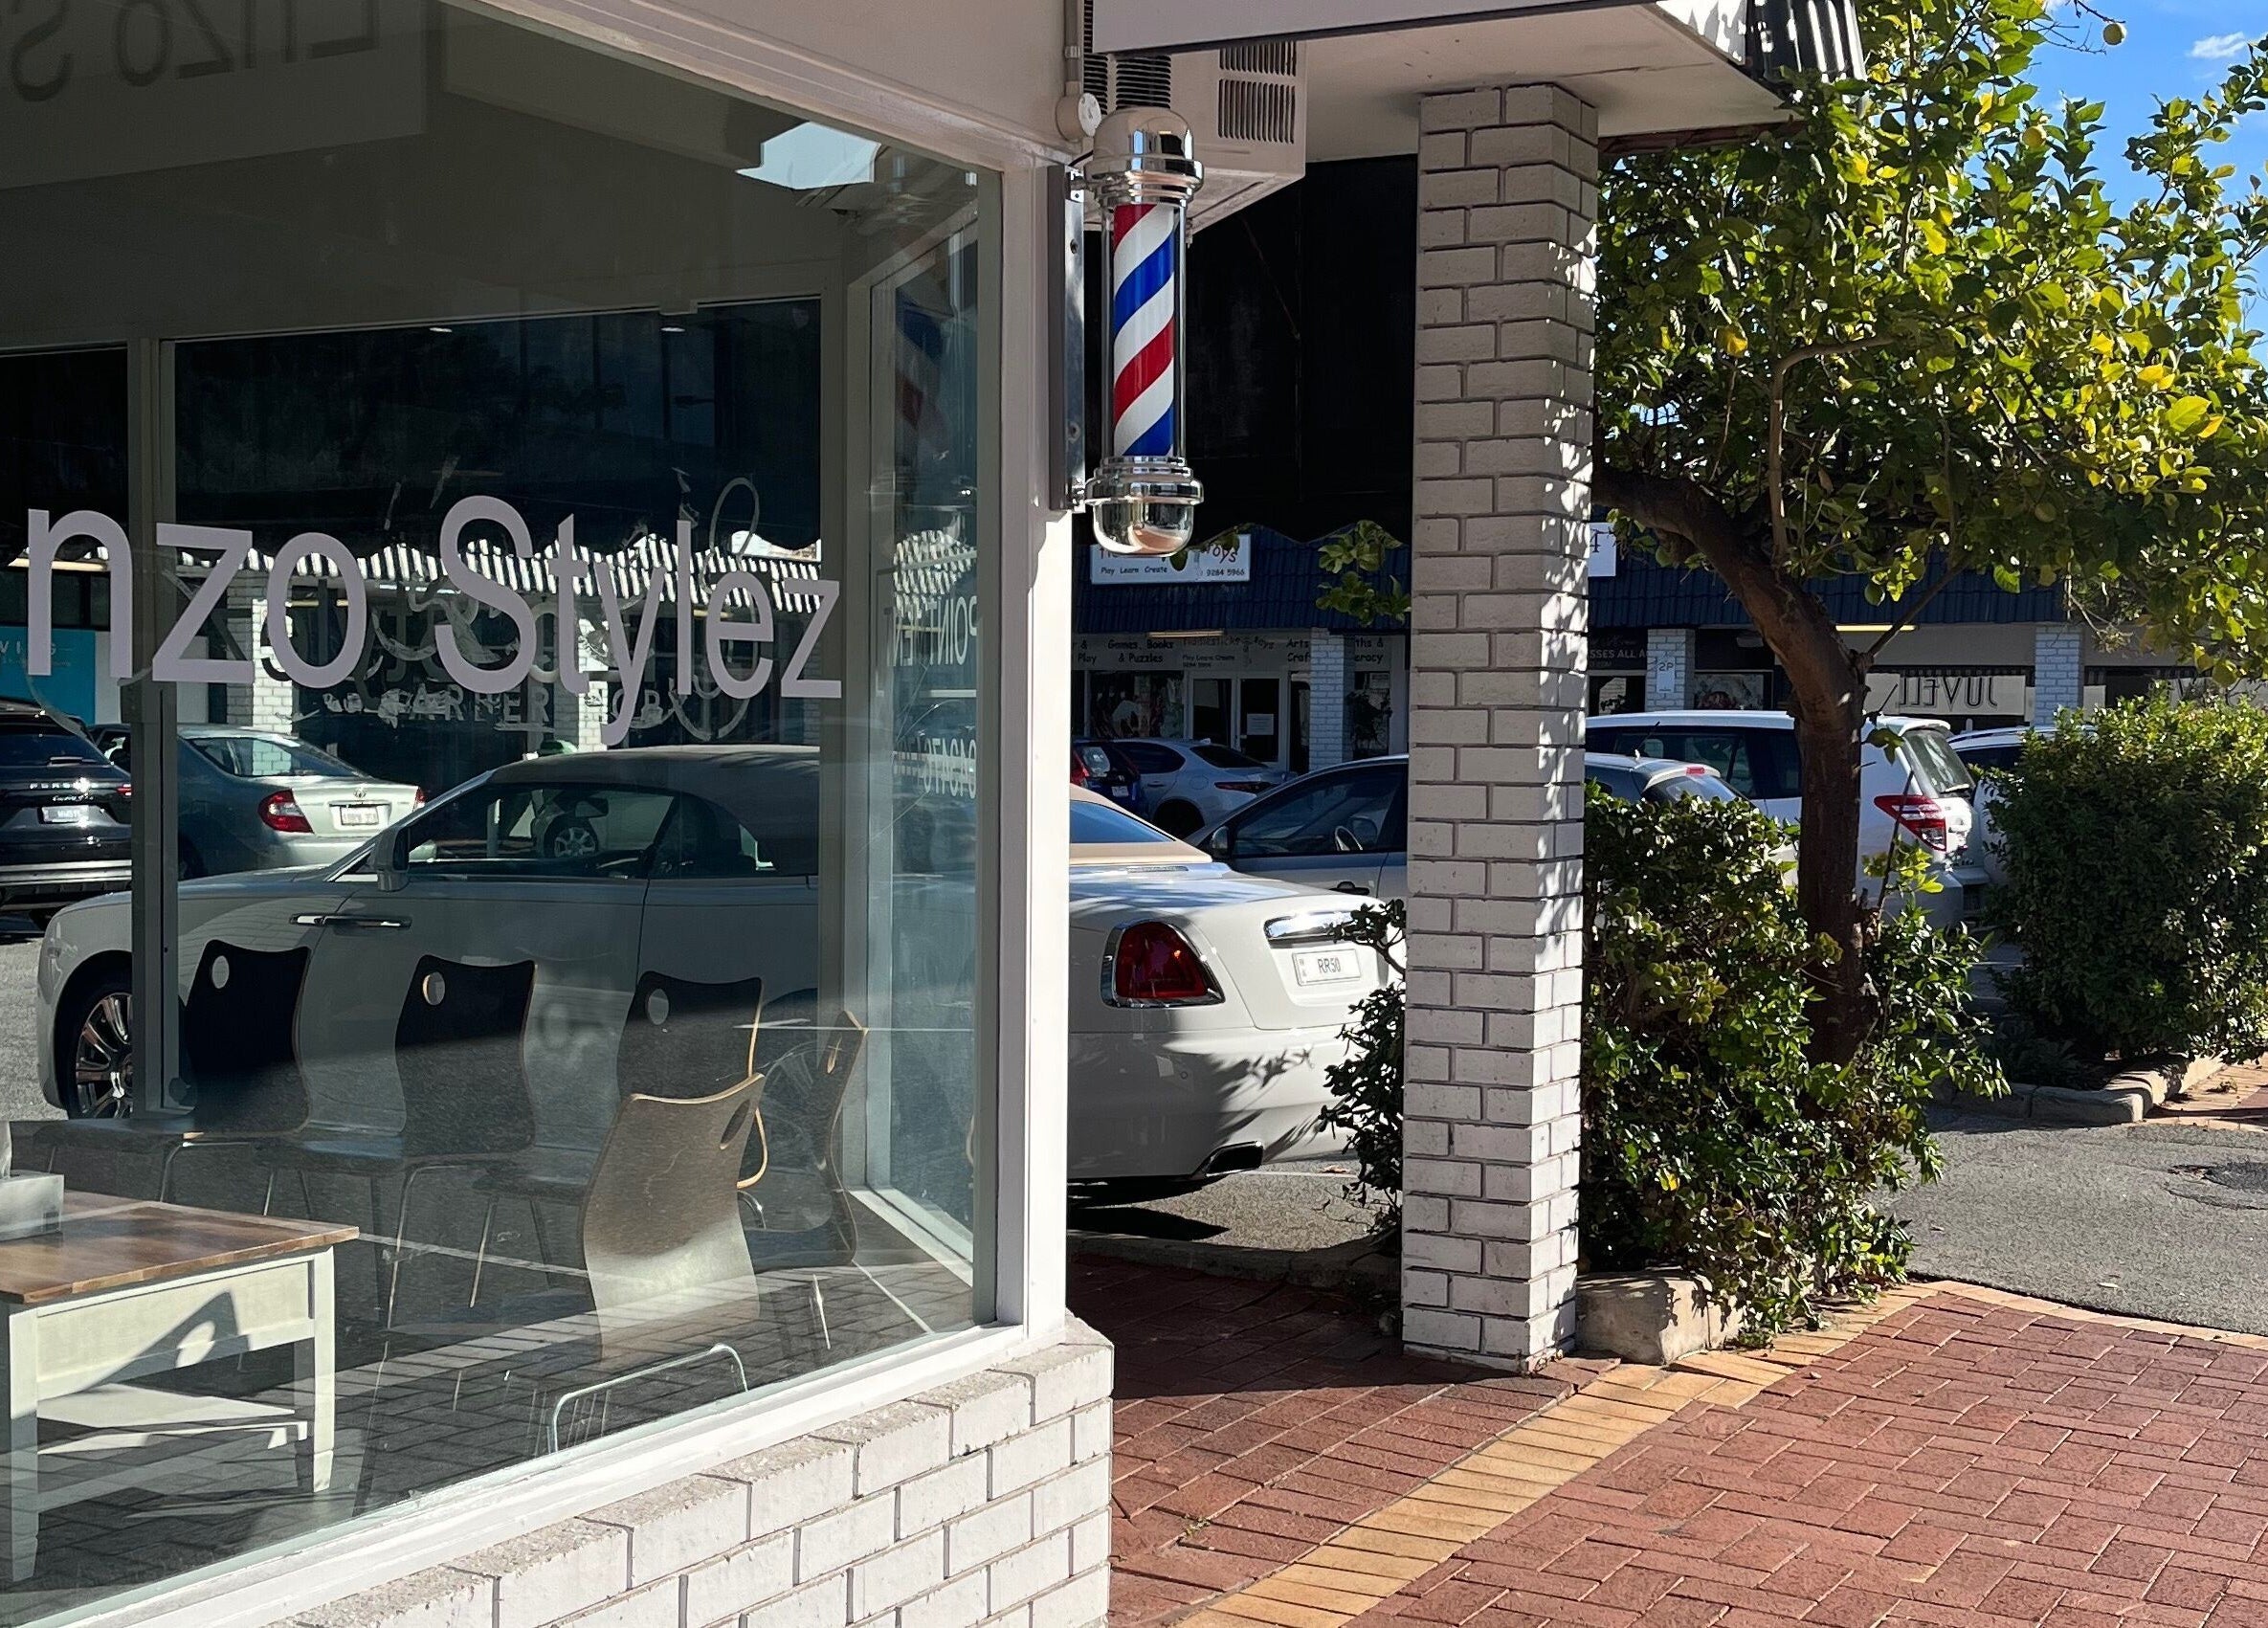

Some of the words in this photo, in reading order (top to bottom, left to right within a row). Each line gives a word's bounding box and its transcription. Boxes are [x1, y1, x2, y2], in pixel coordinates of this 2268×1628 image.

[1101, 567, 1115, 575] Play
[1145, 566, 1167, 574] Create
[1206, 569, 1224, 577] 9284
[434, 495, 842, 747] Stylez
[1147, 638, 1174, 649] Books
[1355, 636, 1372, 648] ths
[1078, 653, 1097, 664] Play
[1128, 652, 1164, 663] Puzzles
[1287, 652, 1311, 662] Craf
[1354, 653, 1384, 664] eracy
[1589, 649, 1615, 658] SSES
[1616, 649, 1635, 658] ALL
[1658, 661, 1674, 671] 2P
